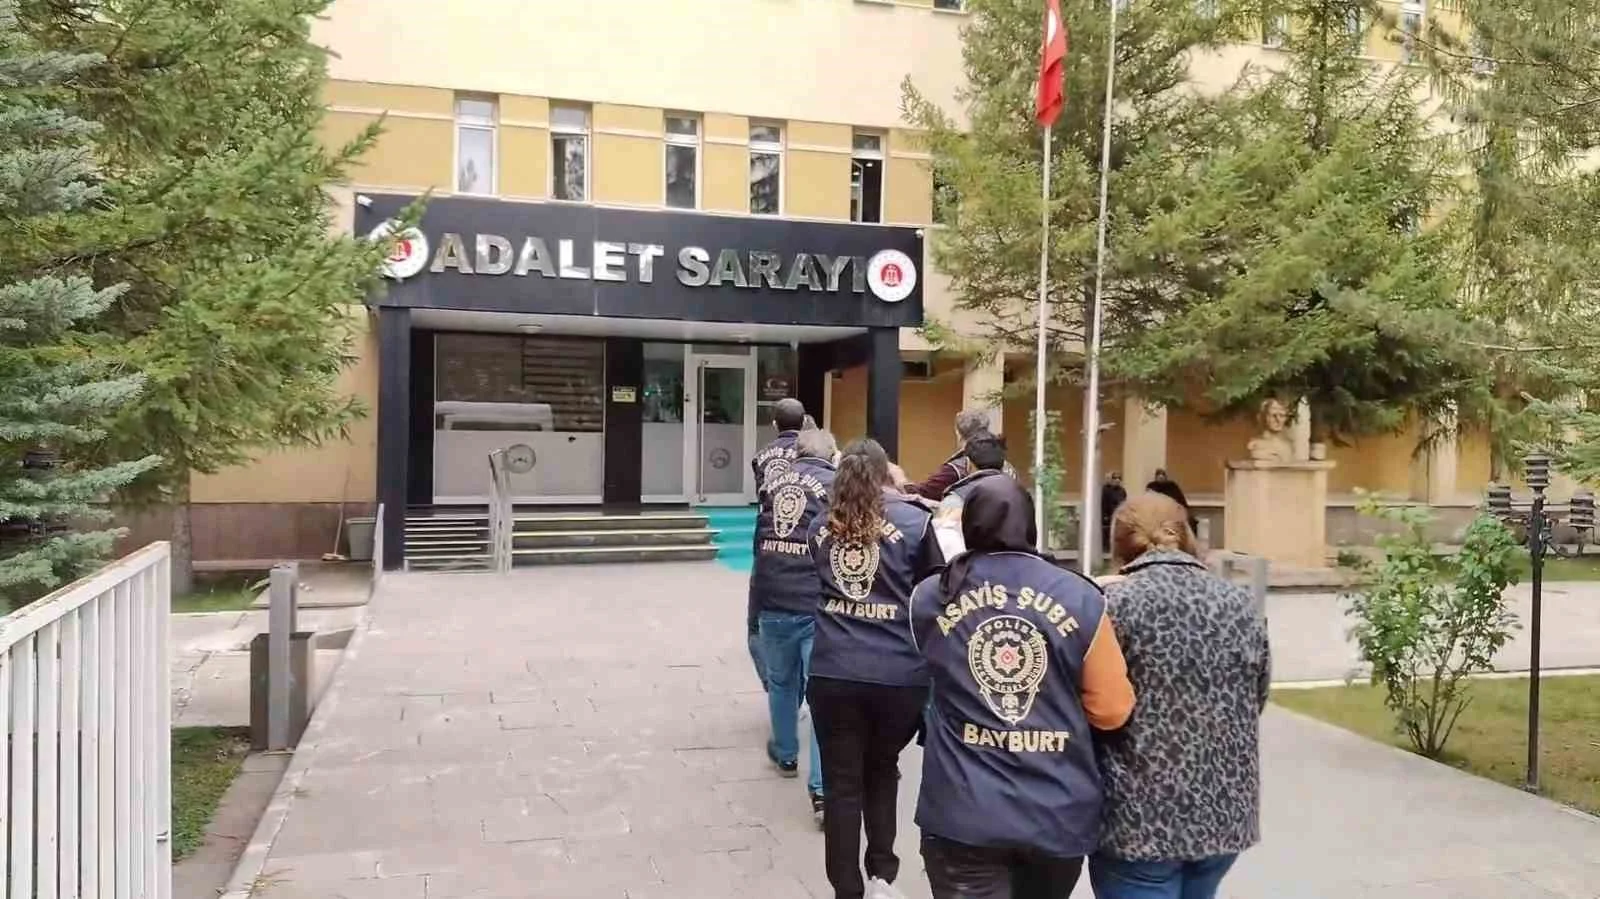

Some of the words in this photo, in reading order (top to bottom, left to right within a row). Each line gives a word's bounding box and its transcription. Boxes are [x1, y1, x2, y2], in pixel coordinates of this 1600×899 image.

[429, 232, 664, 283] ADALET
[676, 247, 865, 293] SARAYI
[825, 599, 898, 620] BAYBURT
[936, 581, 1008, 637] ASAYİŞ
[1017, 586, 1080, 638] ŞUBE
[963, 722, 1069, 752] BAYBURT
